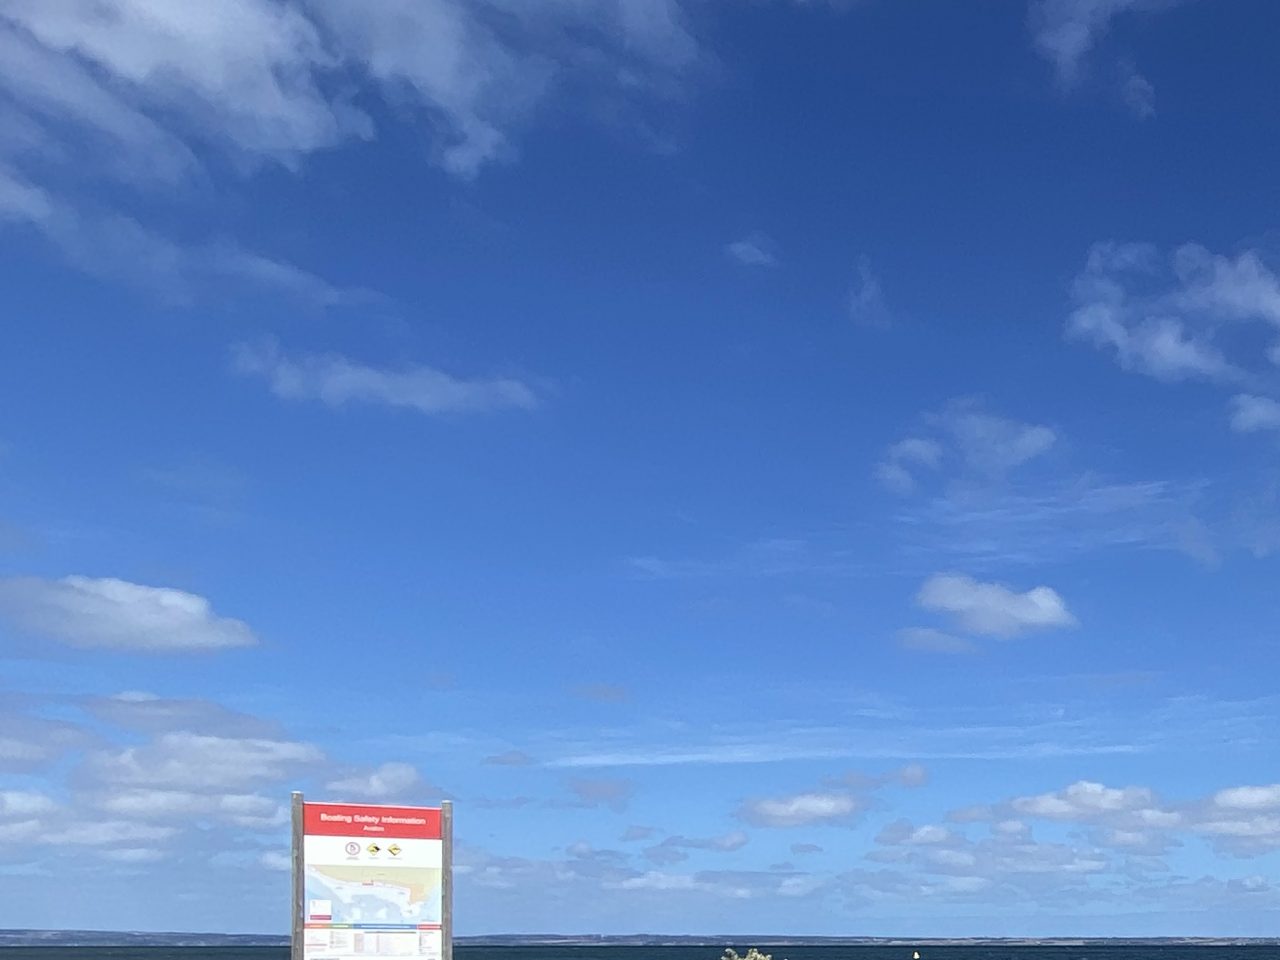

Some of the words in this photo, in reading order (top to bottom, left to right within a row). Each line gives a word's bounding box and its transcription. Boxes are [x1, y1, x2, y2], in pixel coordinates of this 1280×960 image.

[320, 813, 352, 823] Boating
[353, 814, 380, 824] Safety
[381, 815, 426, 825] Information
